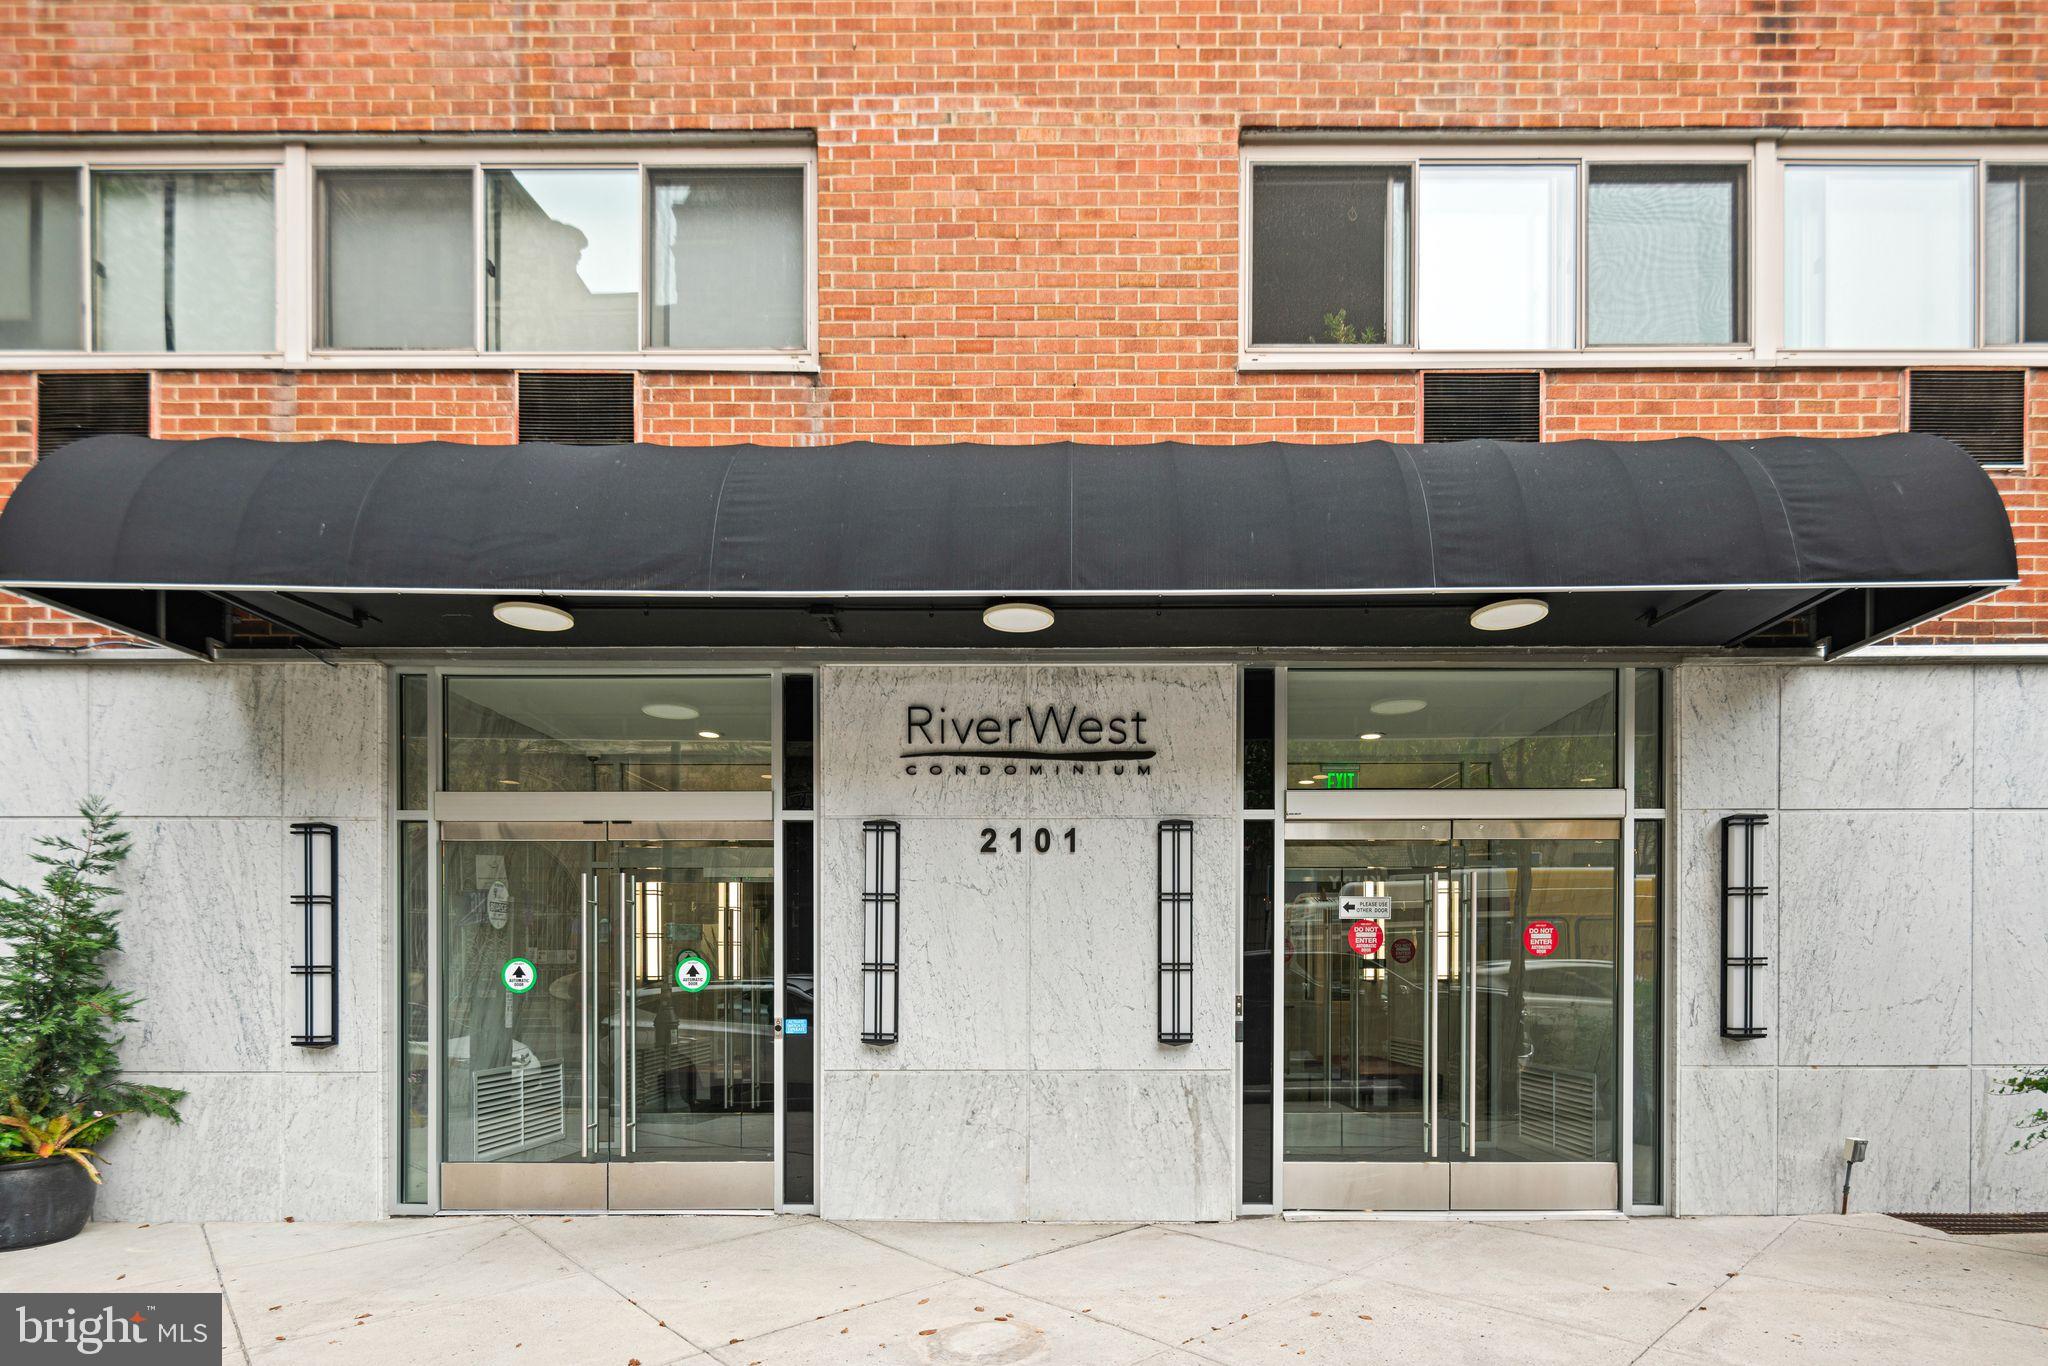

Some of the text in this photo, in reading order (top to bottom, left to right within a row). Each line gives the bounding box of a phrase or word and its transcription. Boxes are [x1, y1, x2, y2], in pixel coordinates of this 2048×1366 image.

[907, 706, 1147, 744] RiverWest
[905, 765, 1151, 775] CONDOMINIUM
[1327, 772, 1354, 788] EXIT
[980, 827, 1077, 853] 2101
